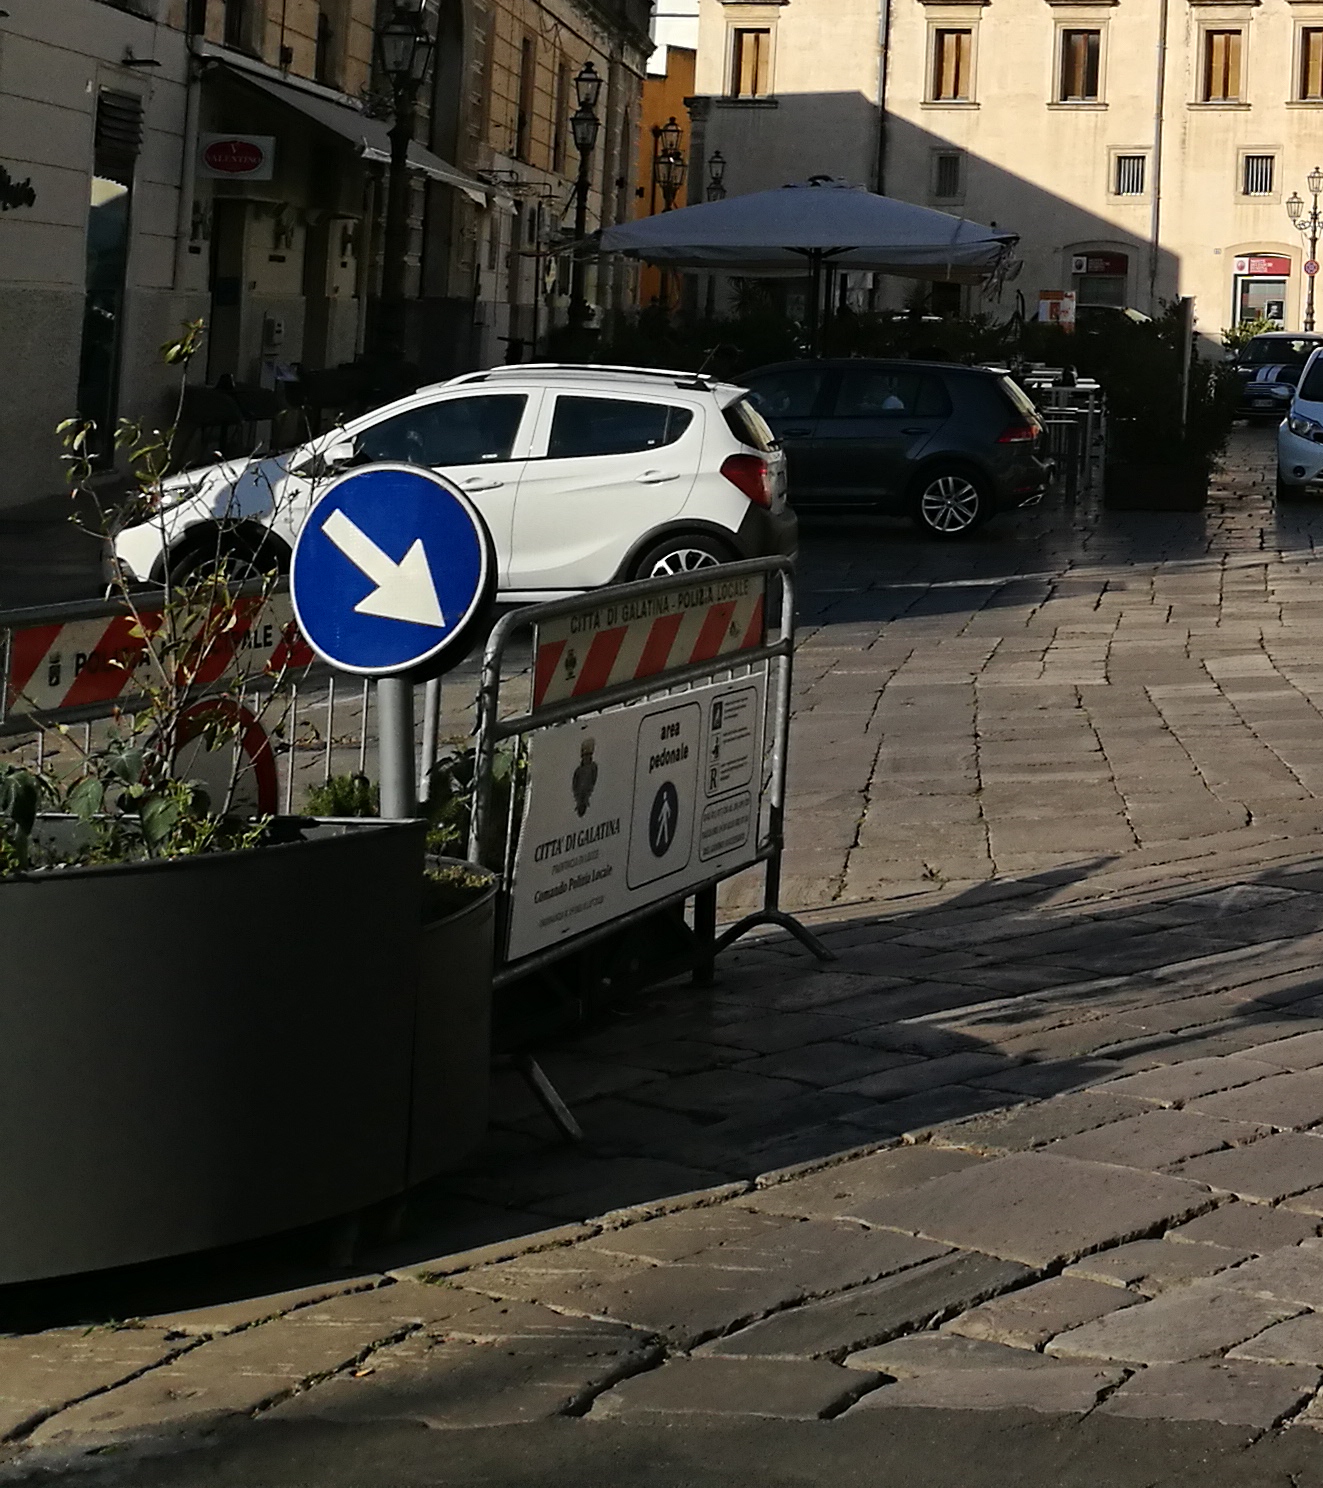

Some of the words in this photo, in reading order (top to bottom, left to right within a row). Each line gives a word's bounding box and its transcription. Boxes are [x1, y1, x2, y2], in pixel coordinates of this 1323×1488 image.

[607, 607, 618, 625] DI
[622, 600, 669, 623] GALATINA
[717, 579, 749, 602] LOCALE
[661, 722, 680, 741] area
[649, 742, 689, 774] pedonale
[565, 834, 575, 852] DI
[578, 818, 620, 847] GALATINA
